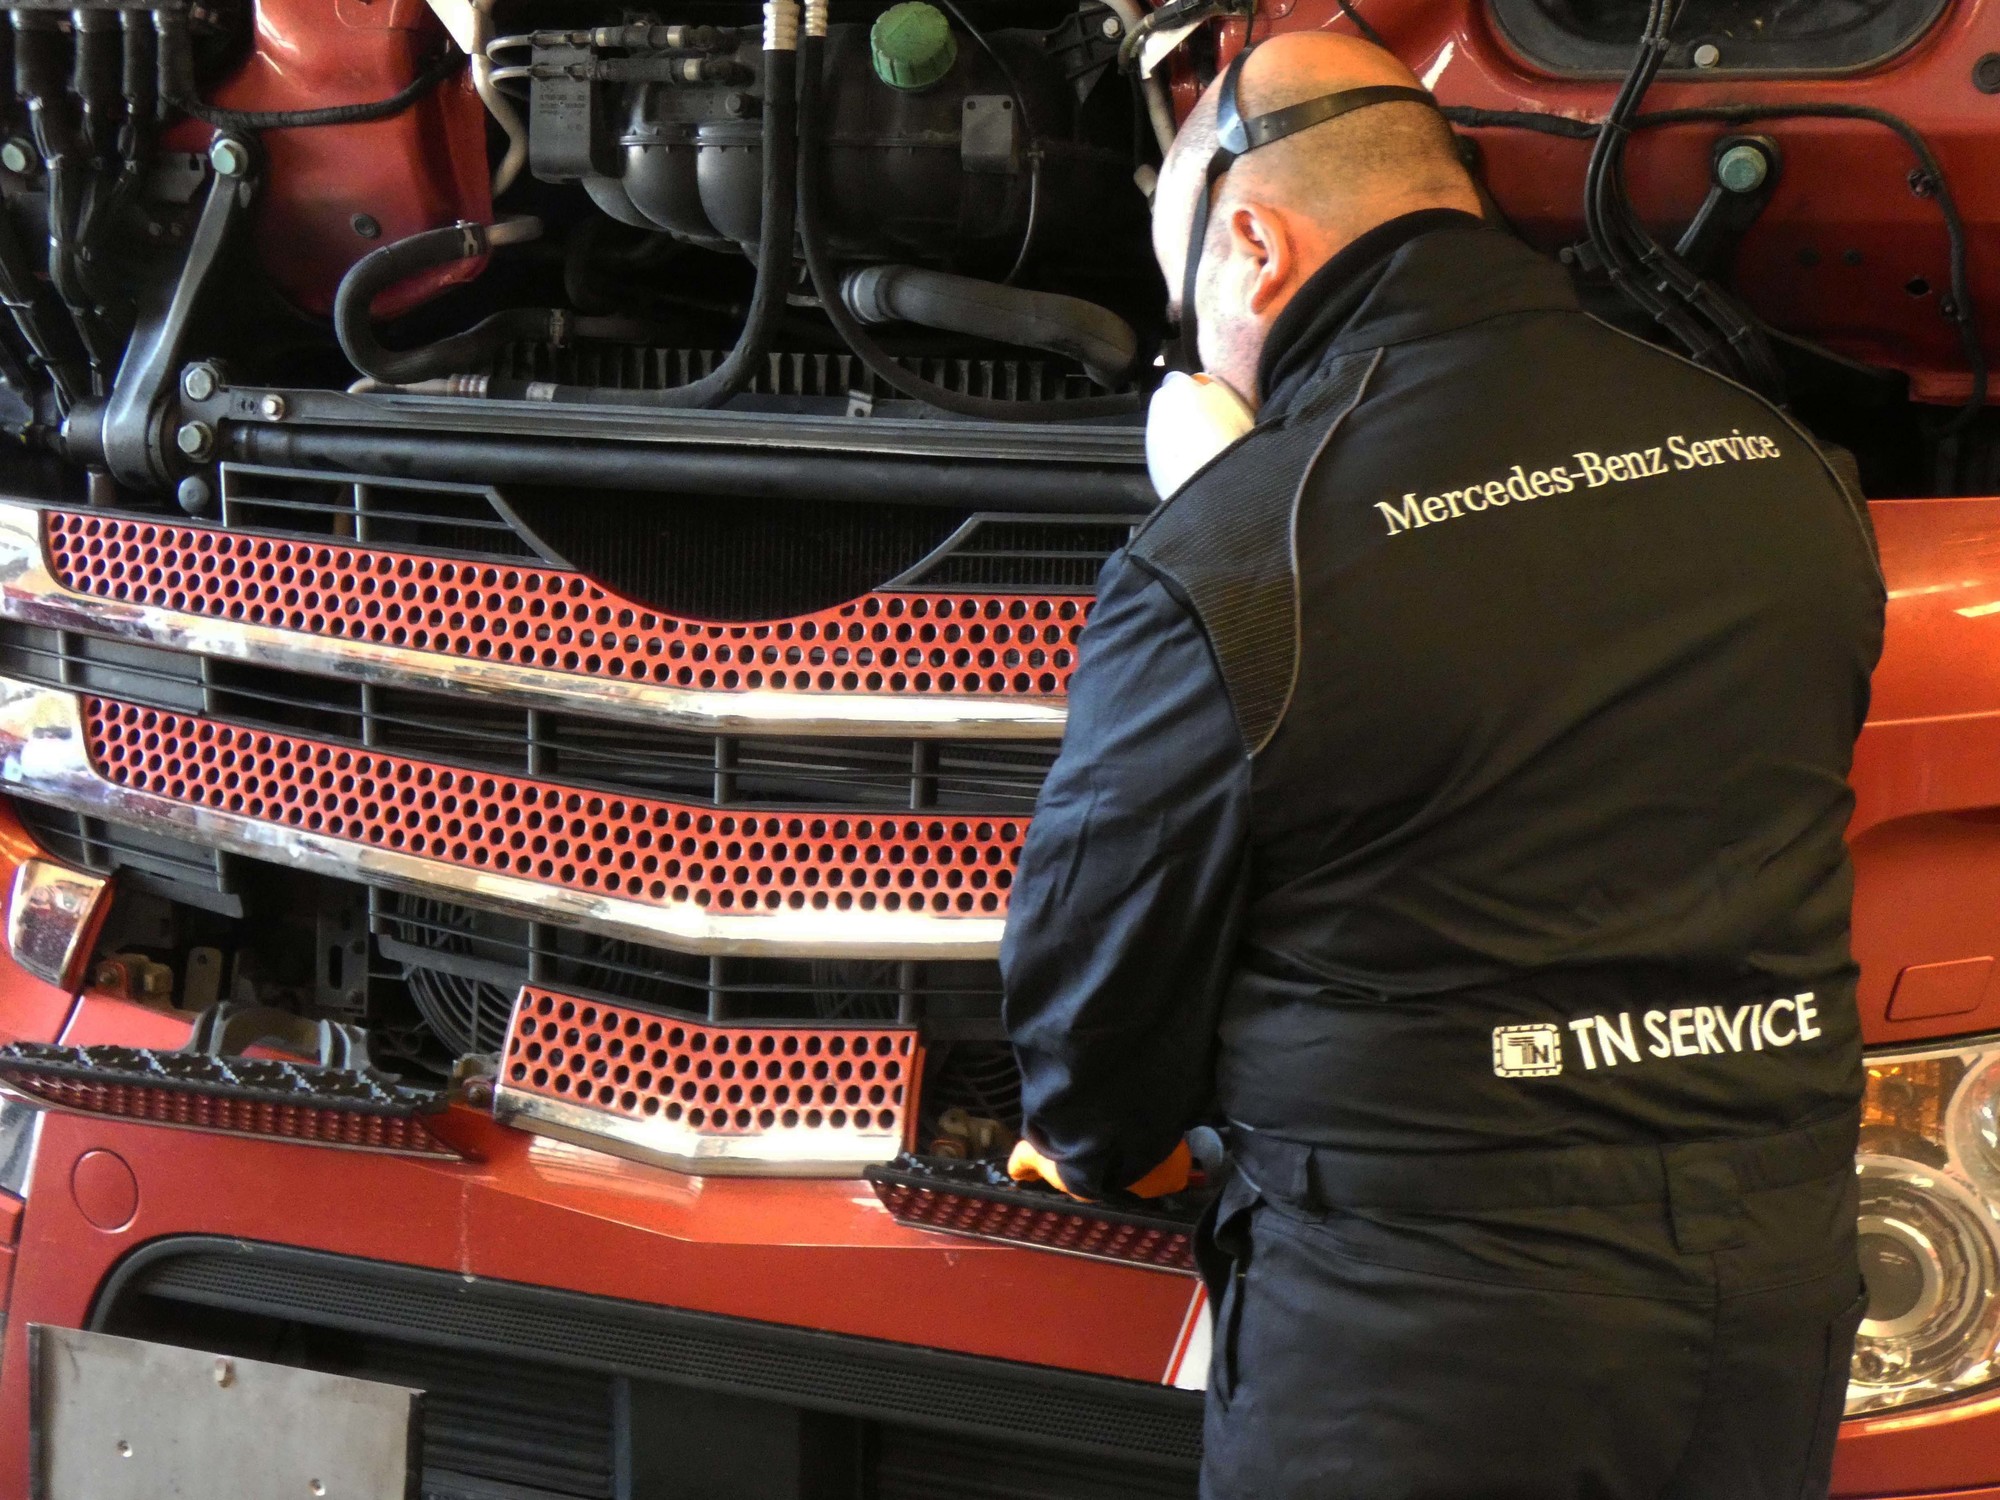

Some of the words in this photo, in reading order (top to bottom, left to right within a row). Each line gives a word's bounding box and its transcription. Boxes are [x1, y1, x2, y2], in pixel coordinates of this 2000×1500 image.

[1374, 447, 1669, 536] Mercedes-Benz
[1667, 429, 1781, 470] Service
[1568, 1012, 1641, 1069] TN
[1643, 992, 1821, 1058] SERVICE
